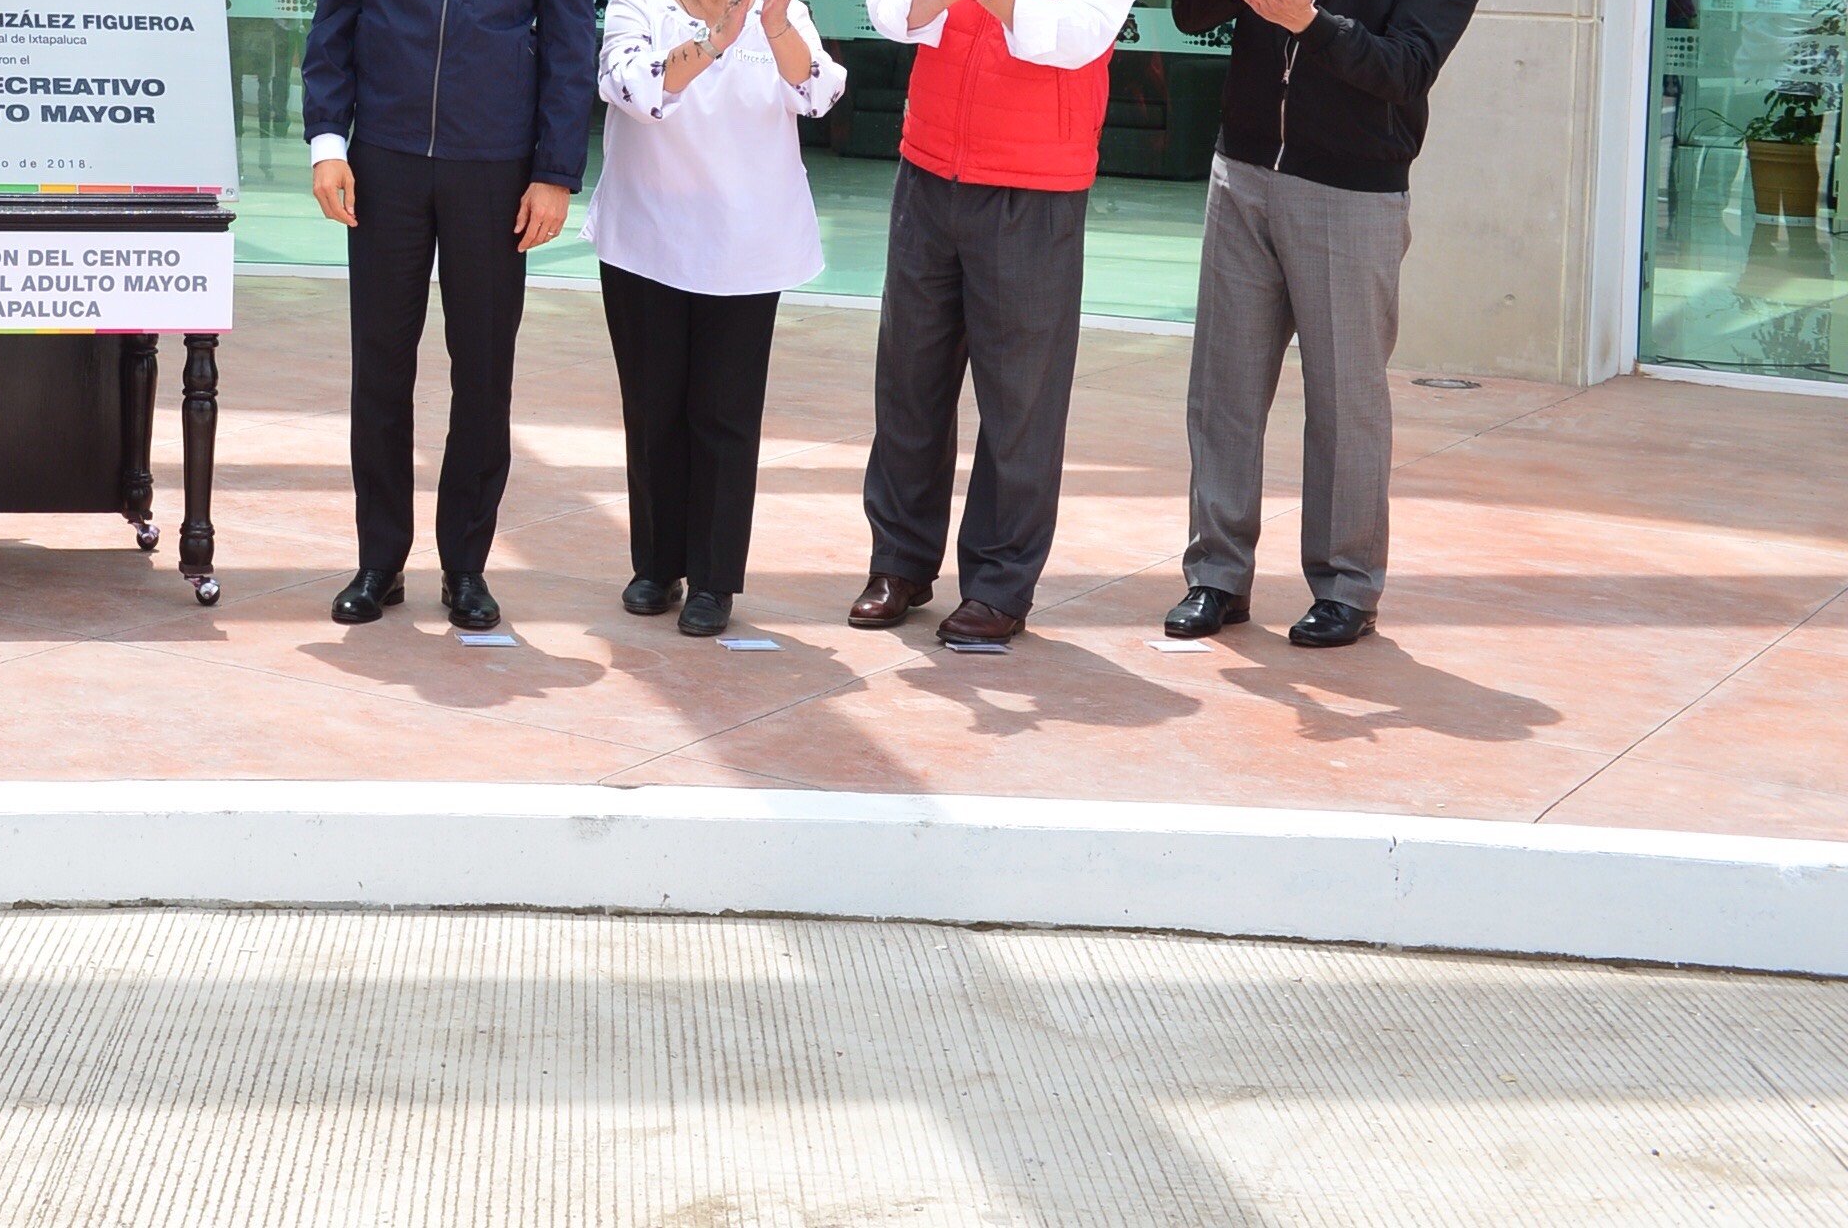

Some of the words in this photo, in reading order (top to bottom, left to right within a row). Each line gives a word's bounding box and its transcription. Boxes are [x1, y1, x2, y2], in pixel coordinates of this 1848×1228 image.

[82, 14, 195, 31] FIGUEROA
[10, 34, 25, 43] de
[28, 34, 87, 46] Ixtapaluca
[20, 55, 30, 65] el
[41, 105, 156, 123] MAYOR
[19, 159, 37, 168] de
[47, 159, 93, 169] 2018.
[28, 249, 74, 267] DEL
[83, 249, 181, 267] CENTRO
[21, 275, 115, 292] ADULTO
[124, 275, 208, 292] MAYOR
